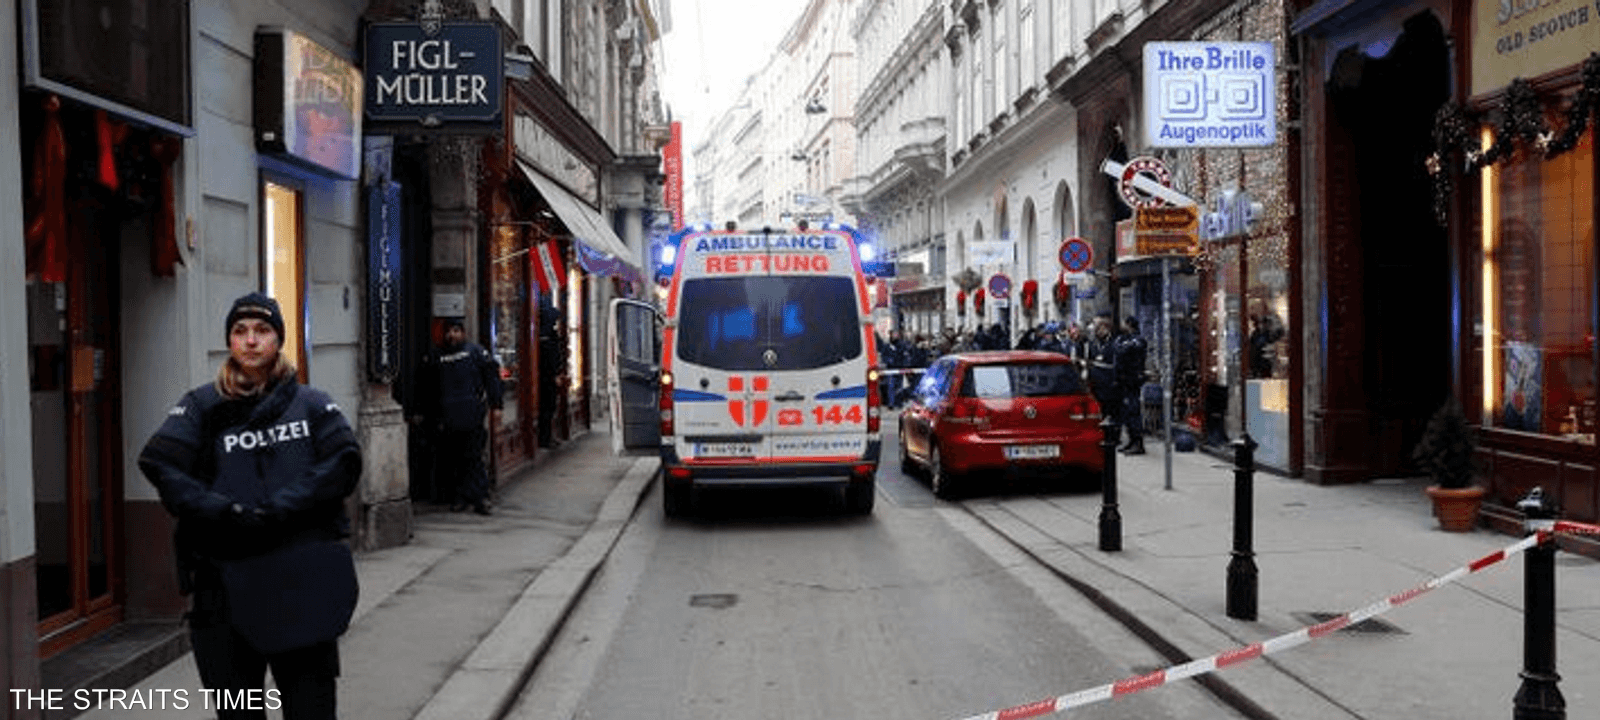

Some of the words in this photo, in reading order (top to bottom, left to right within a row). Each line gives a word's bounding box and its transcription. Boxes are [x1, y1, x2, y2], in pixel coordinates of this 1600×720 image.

[1496, 31, 1523, 55] OLD
[1528, 5, 1590, 43] SCOTCH
[392, 40, 476, 70] FIGL-
[376, 72, 489, 105] MÜLLER
[1160, 123, 1266, 143] Augenoptik
[695, 233, 838, 252] AMBULANCE
[705, 254, 831, 275] RETTUNG
[811, 403, 865, 426] 144
[223, 419, 310, 452] POLIZEI
